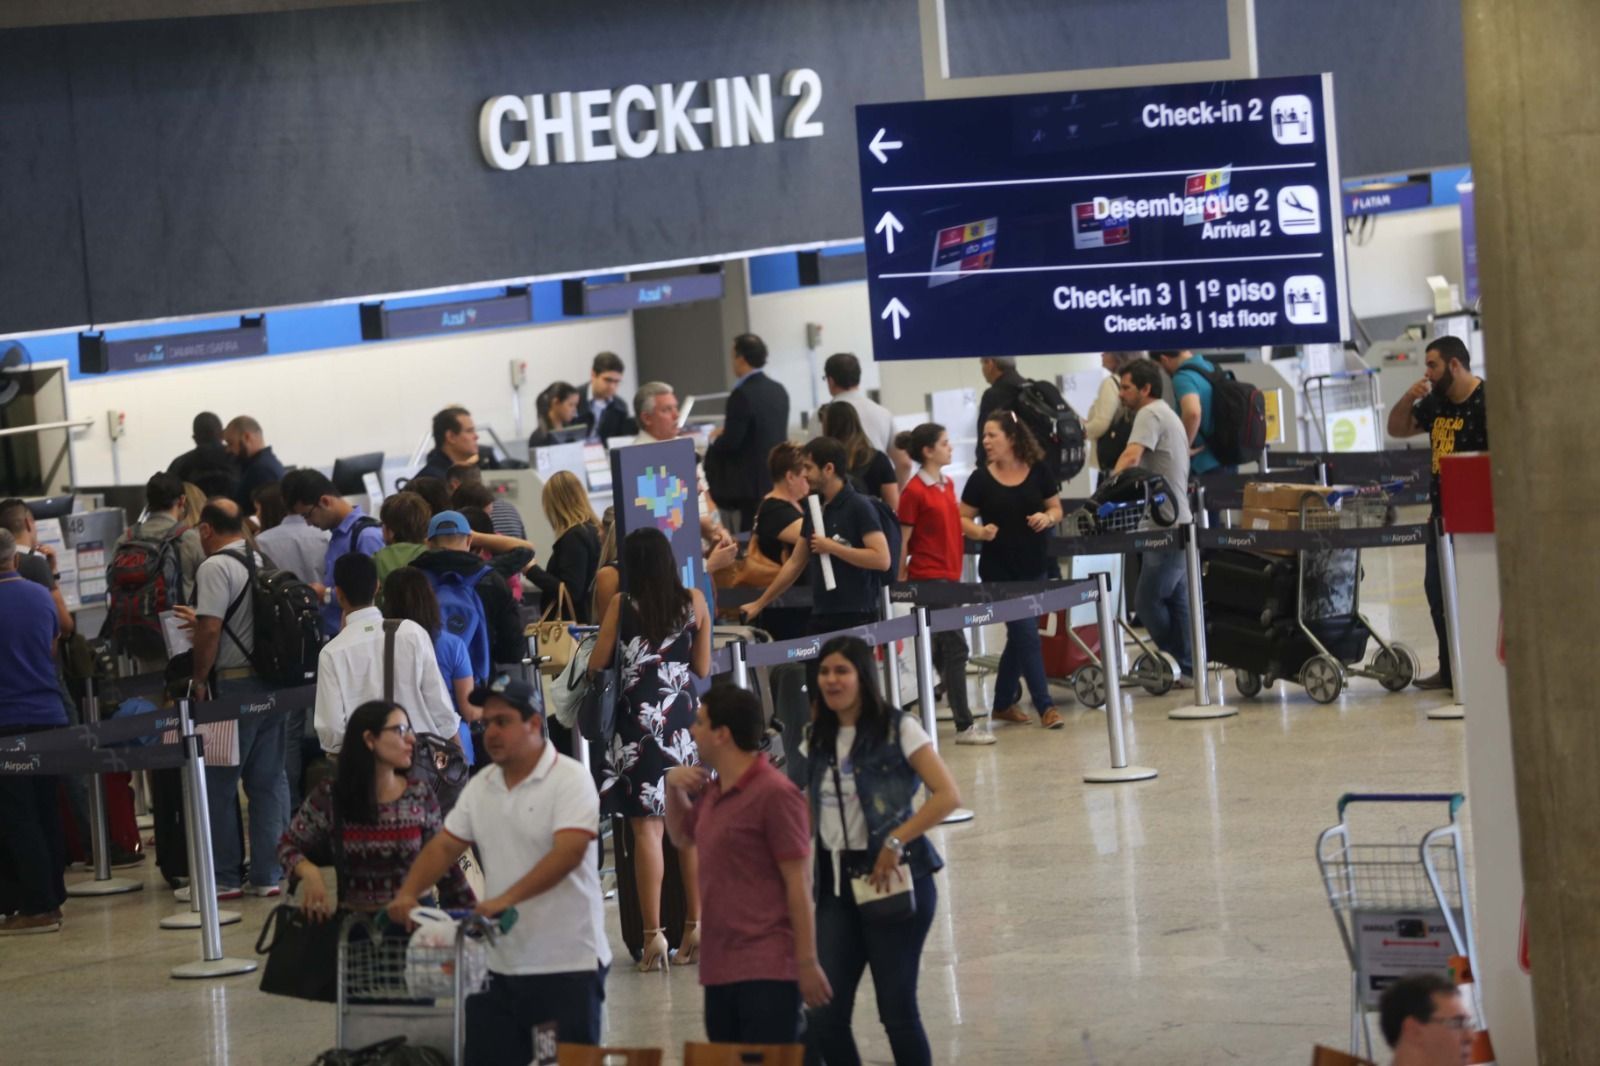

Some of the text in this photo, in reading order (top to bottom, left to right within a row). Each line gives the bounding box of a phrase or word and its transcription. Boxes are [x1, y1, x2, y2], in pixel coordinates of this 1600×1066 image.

[480, 69, 824, 171] CHECK-IN 2
[1142, 98, 1264, 128] Check-in 2
[1093, 188, 1270, 220] Desembarque 2
[1360, 195, 1391, 209] LATAM
[1201, 220, 1272, 240] Arrival 2
[639, 286, 661, 303] Azul
[1053, 284, 1152, 310] Check-in
[1157, 282, 1172, 304] 3
[1227, 278, 1276, 309] piso
[441, 310, 466, 326] Azul
[1104, 310, 1278, 333] Check-in 3 1st floor
[69, 518, 84, 533] 48
[890, 588, 912, 600] Airport
[964, 613, 990, 625] BHAirport
[240, 701, 271, 715] BHAirport
[156, 716, 179, 729] BHAirp
